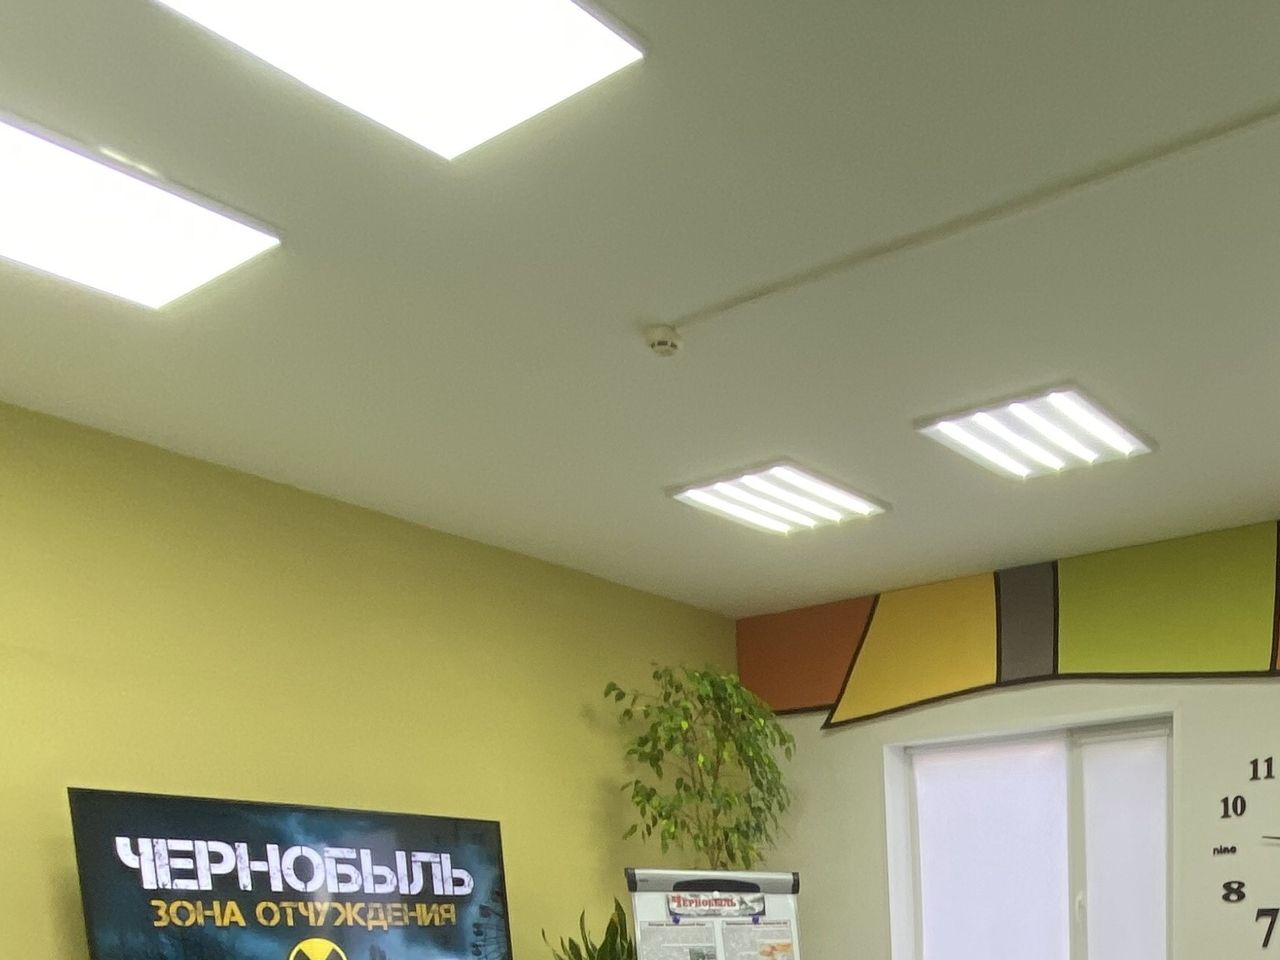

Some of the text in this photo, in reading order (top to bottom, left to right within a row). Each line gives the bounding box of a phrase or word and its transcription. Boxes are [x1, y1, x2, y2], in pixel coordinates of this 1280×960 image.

[1249, 756, 1275, 781] 11
[1220, 795, 1246, 818] 10
[1212, 844, 1237, 856] nine
[114, 836, 475, 896] ЧЕРНОБЫЛЬ
[1221, 880, 1246, 903] 8
[150, 899, 457, 931] ЗОНА ОТЧУЖДЕНИЯ
[1254, 907, 1280, 949] 7
